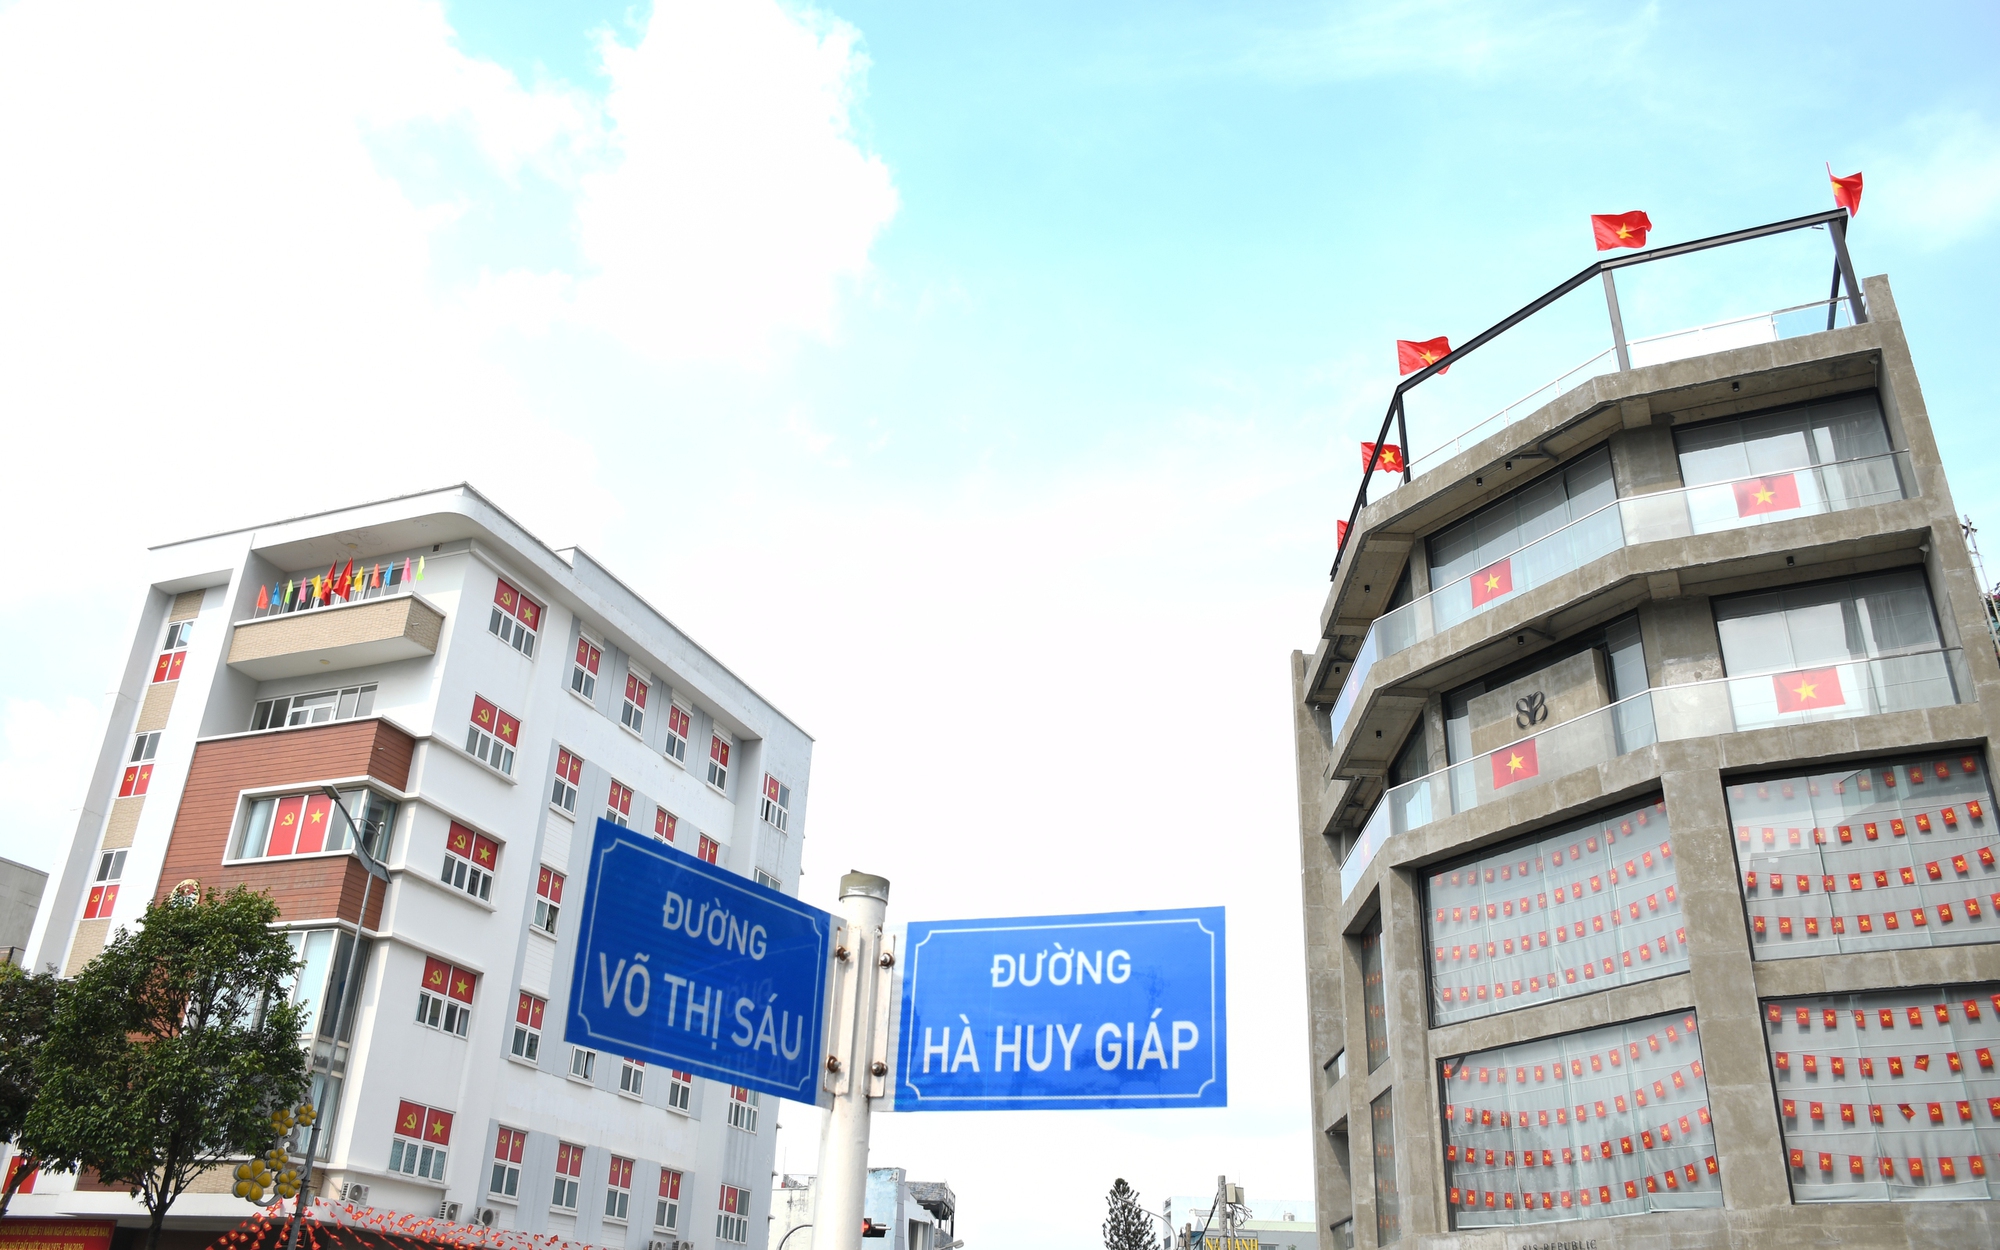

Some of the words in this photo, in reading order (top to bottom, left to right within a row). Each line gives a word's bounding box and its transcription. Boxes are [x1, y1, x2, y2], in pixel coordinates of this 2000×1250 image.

[663, 891, 767, 960] ĐƯỜNG
[991, 942, 1131, 987] ĐƯỜNG
[600, 952, 650, 1017] VÕ
[664, 973, 722, 1050] THỊ
[731, 993, 803, 1060] SÁU
[923, 1014, 980, 1073] HÀ
[995, 1024, 1082, 1072] HUY
[1095, 1007, 1199, 1070] GIÁP
